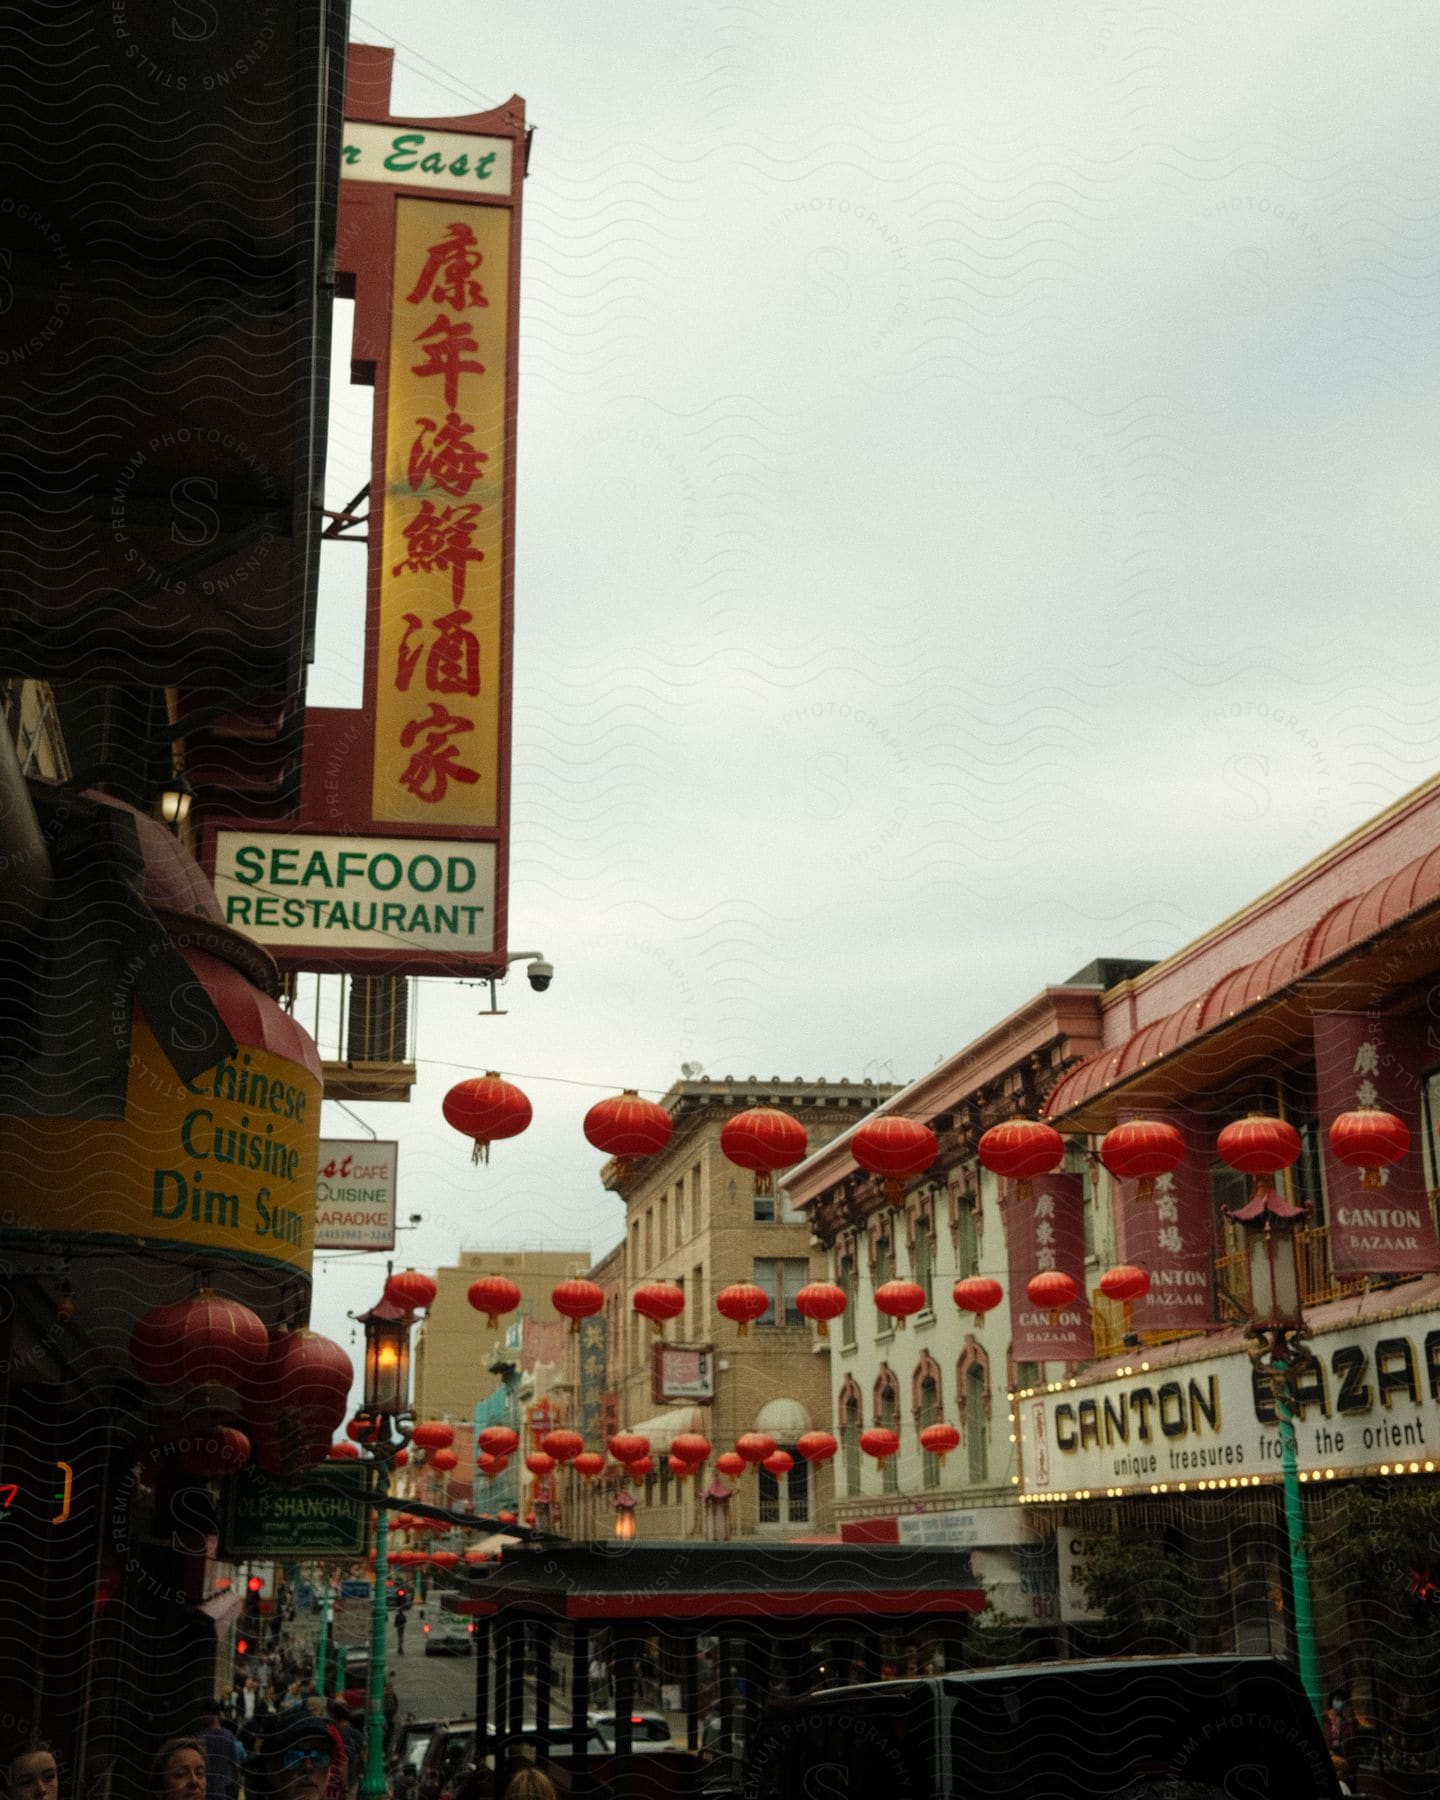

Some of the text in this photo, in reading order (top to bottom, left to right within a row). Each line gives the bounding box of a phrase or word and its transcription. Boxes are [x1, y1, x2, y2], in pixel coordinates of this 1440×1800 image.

[383, 134, 497, 180] East
[392, 222, 490, 804] 康年海鮮酒家
[235, 846, 476, 893] SEAFOOD
[226, 896, 484, 955] RESTAURANT
[182, 1109, 298, 1182] Cuisine
[153, 1168, 303, 1248] Dim Sum
[317, 1182, 387, 1203] CUISINE
[1337, 1208, 1421, 1229] CANTON
[1351, 1236, 1418, 1250] BAZAAR
[1151, 1271, 1206, 1287] ANTON
[1026, 1331, 1076, 1343] BAZAAR
[1055, 1375, 1222, 1453] CANTON
[1113, 1453, 1157, 1479] unique
[1169, 1443, 1244, 1470] treasures
[1316, 1428, 1344, 1454] the
[1363, 1416, 1425, 1449] orient
[273, 1498, 357, 1518] SHANGHAI
